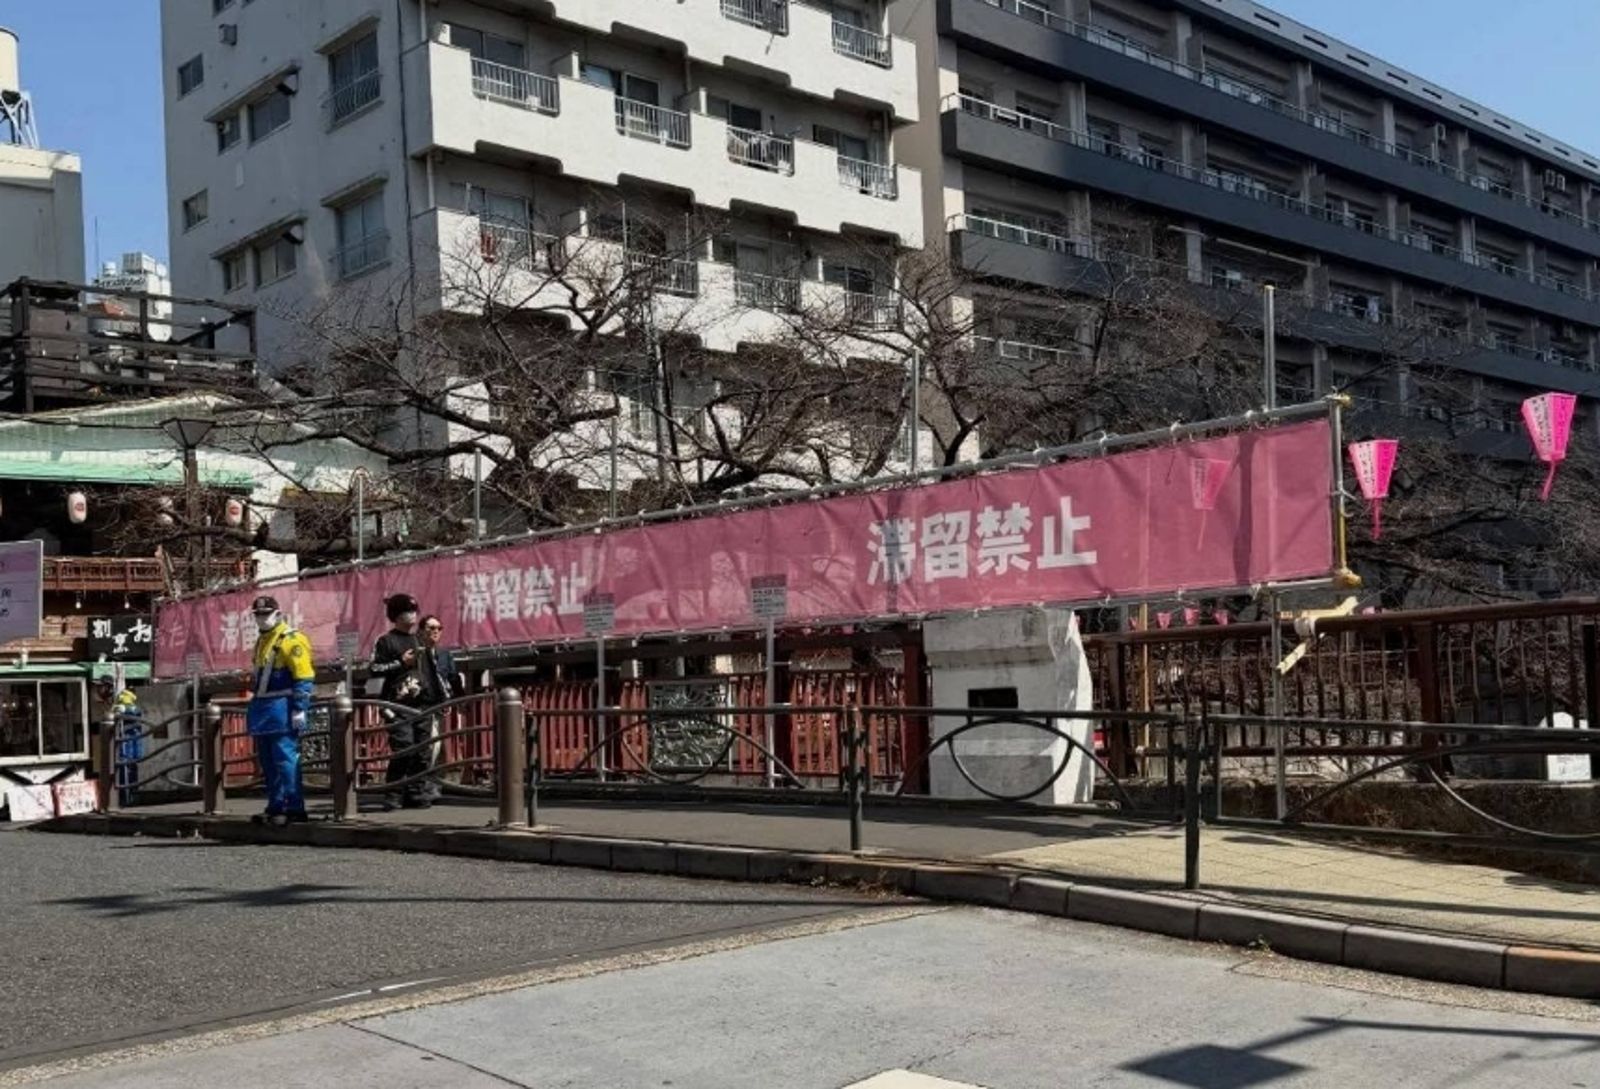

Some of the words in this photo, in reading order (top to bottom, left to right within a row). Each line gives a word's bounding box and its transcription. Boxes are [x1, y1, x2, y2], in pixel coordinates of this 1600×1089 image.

[866, 495, 1097, 586] 滞留禁止
[462, 561, 587, 623] 滞留禁止
